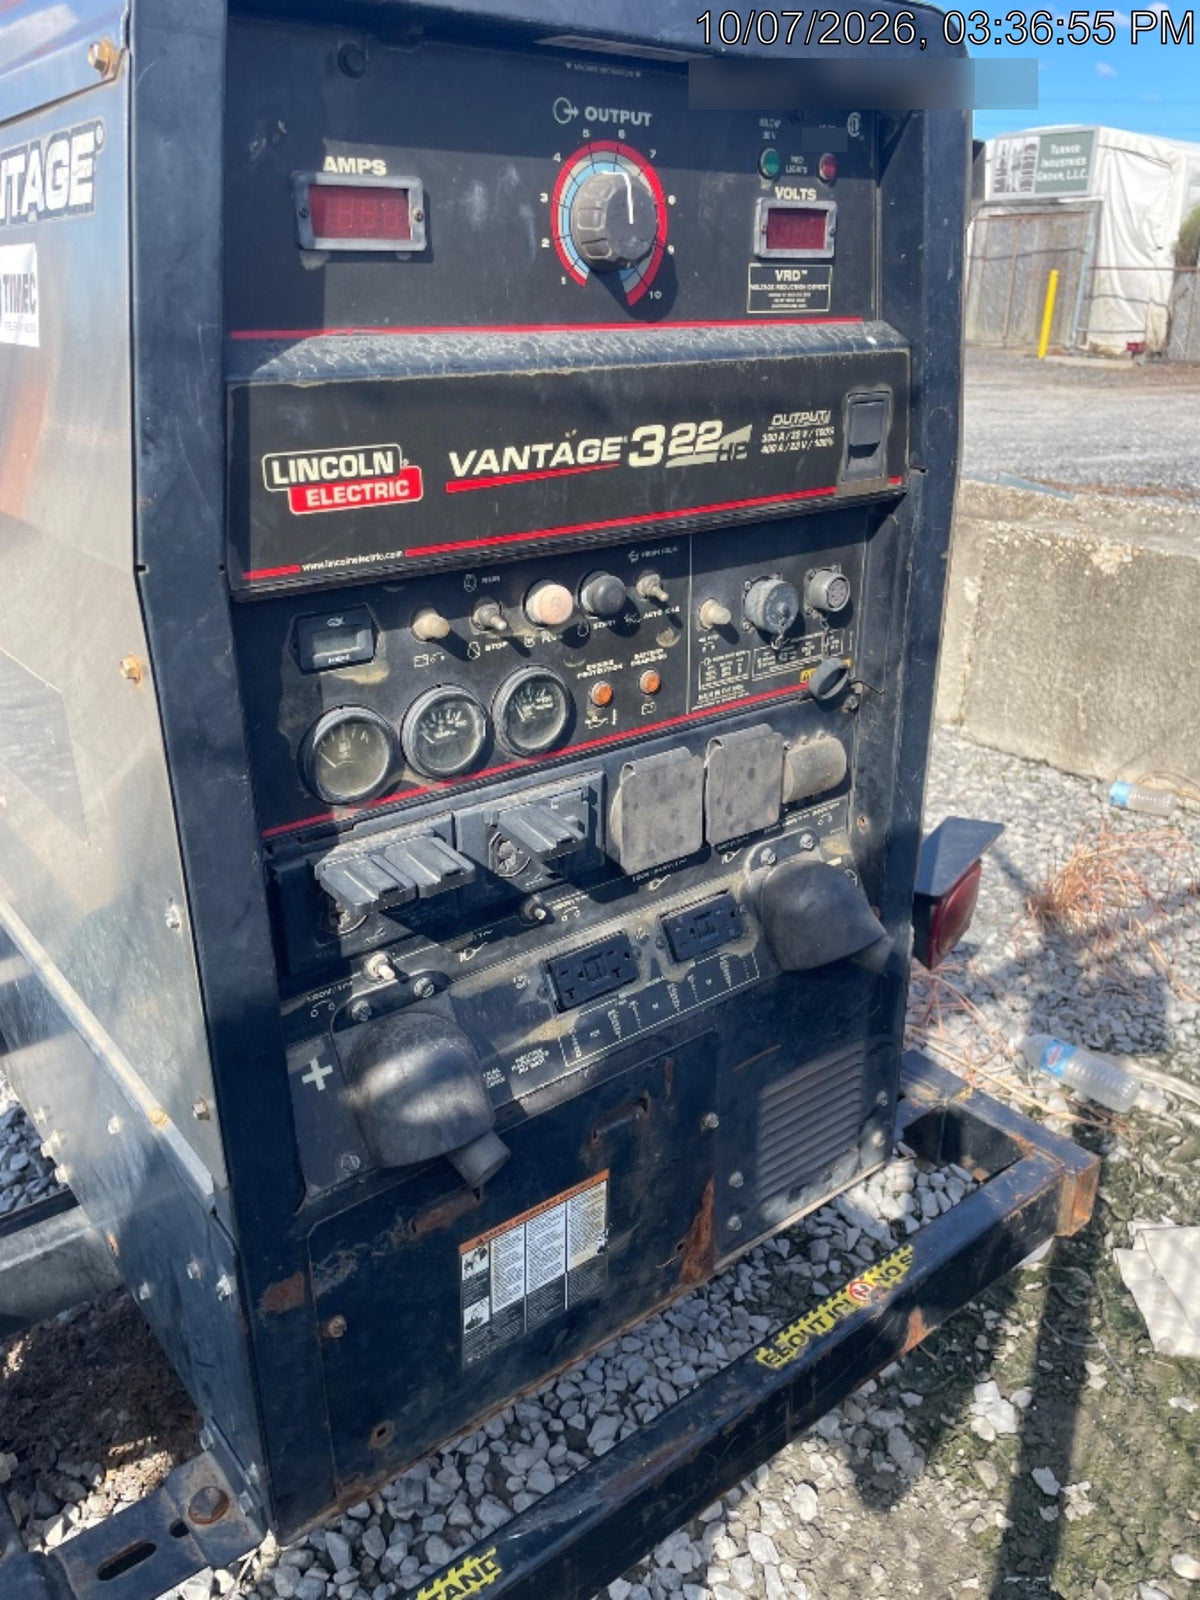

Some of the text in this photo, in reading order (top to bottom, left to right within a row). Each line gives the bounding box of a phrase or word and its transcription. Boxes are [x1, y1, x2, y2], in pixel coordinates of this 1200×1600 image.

[584, 106, 652, 127] OUTPUT
[583, 129, 626, 139] 5 6
[553, 149, 657, 162] 4 7
[323, 156, 387, 176] AMPS
[540, 193, 548, 203] 3
[775, 187, 817, 200] VOLTS
[542, 238, 675, 254] 2 9
[650, 290, 662, 299] 10
[772, 411, 830, 425] OUTPUT
[448, 435, 617, 477] VANTAGE
[628, 419, 723, 467] 322
[271, 451, 394, 484] LINCOLN
[306, 479, 410, 507] ELECTRIC
[485, 641, 508, 652] STOP
